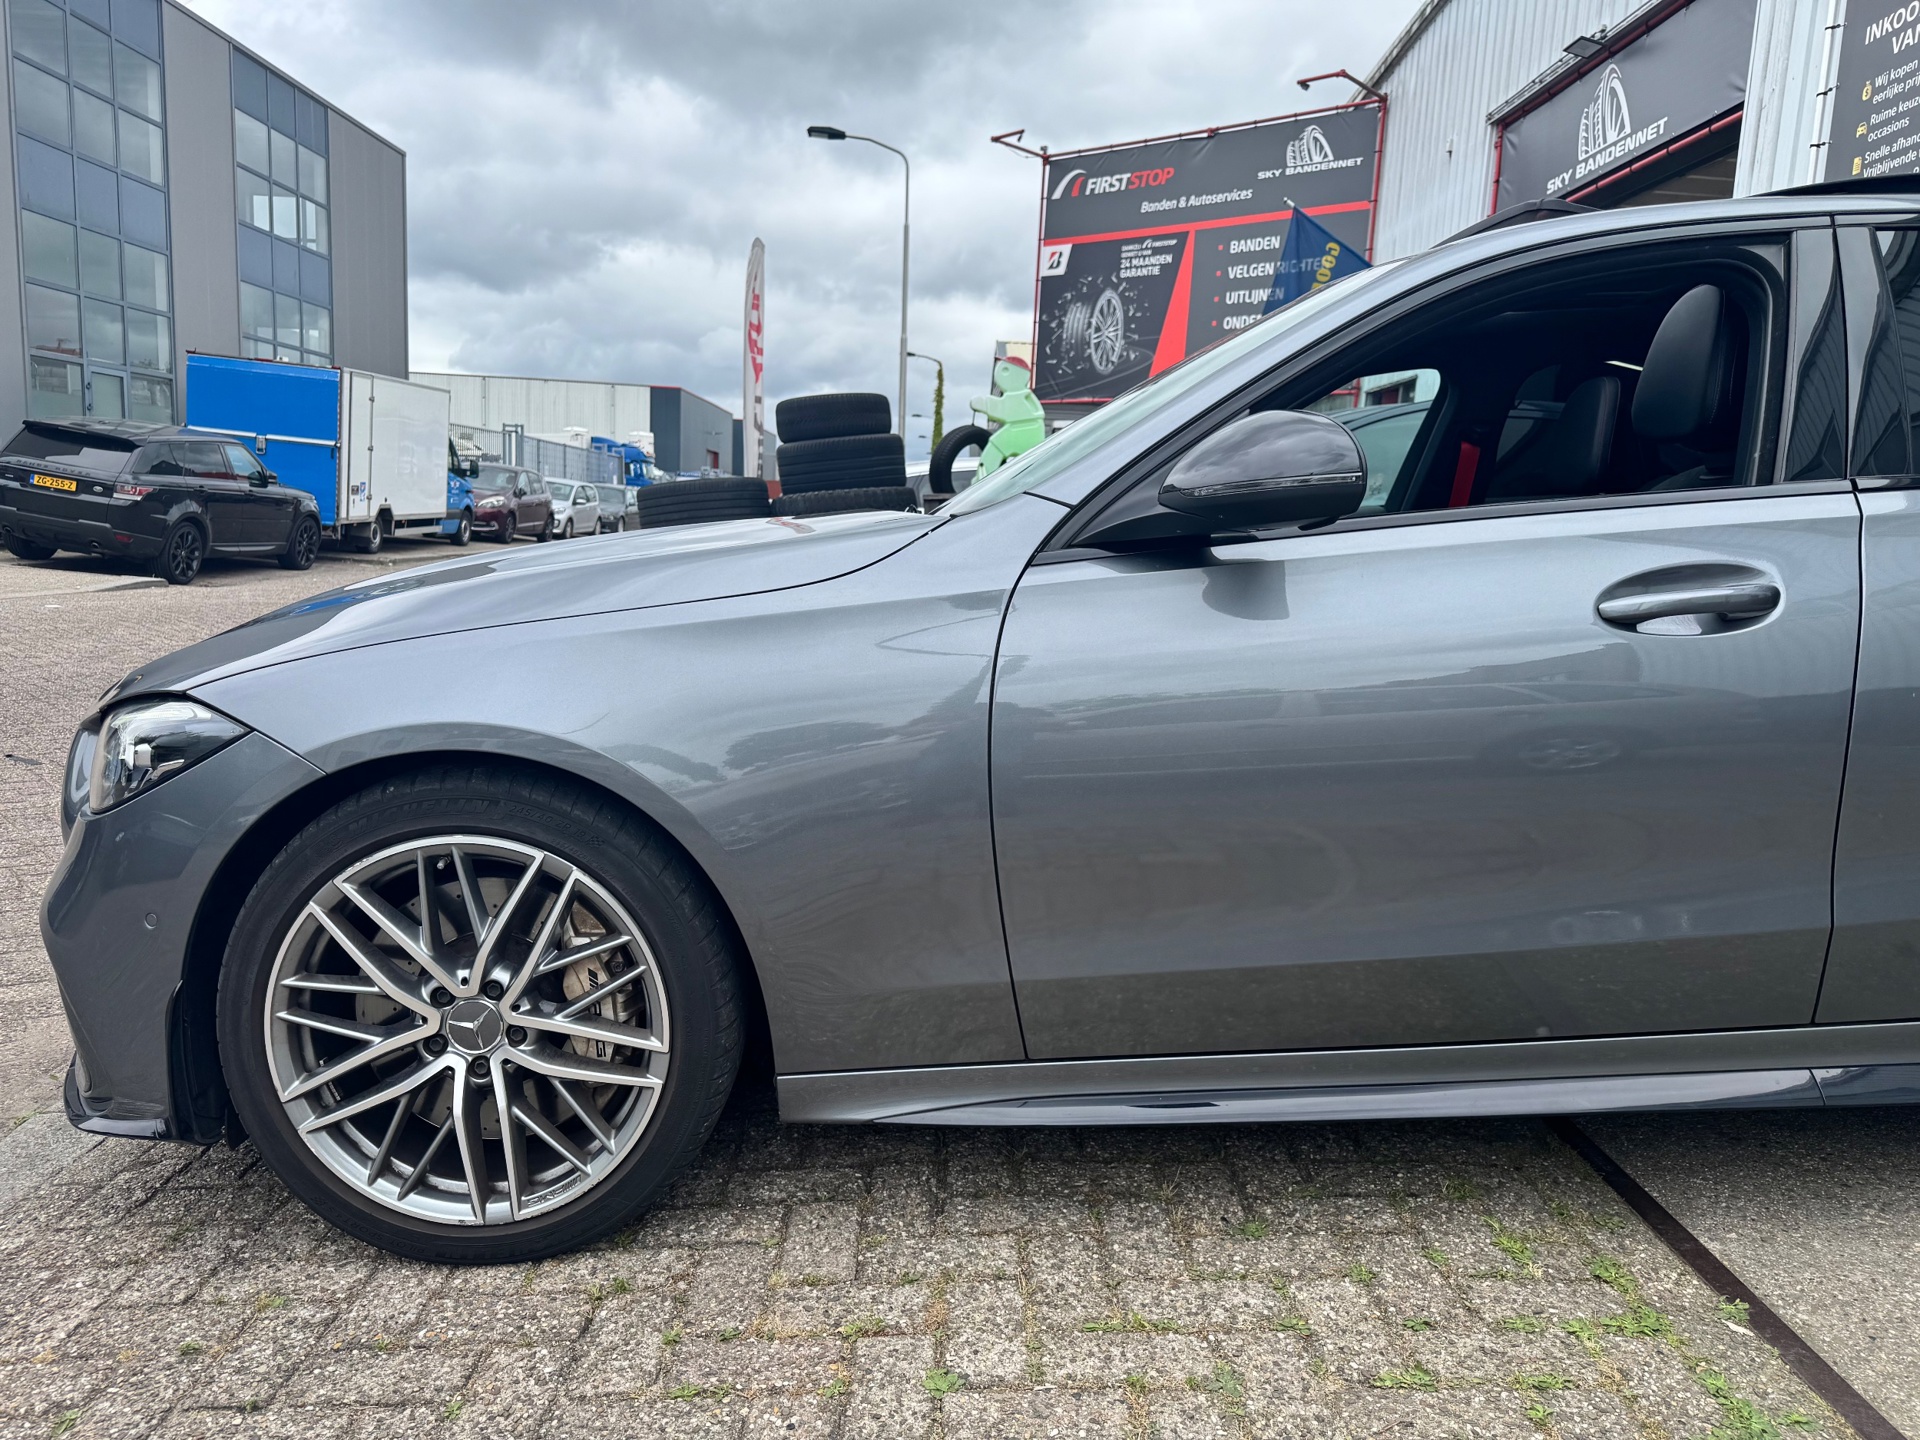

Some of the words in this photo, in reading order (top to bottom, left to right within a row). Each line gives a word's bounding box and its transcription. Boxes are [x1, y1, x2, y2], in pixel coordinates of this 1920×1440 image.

[1865, 0, 1920, 46] INKOO
[1875, 71, 1889, 88] Wij
[1890, 60, 1919, 81] kopen
[1872, 82, 1905, 104] eerlijke
[1870, 106, 1898, 126] Ruime
[1867, 117, 1910, 142] occasions
[1546, 169, 1573, 195] SKY
[1575, 117, 1668, 180] BANDENNET
[1863, 150, 1918, 178] Vrijblijvende
[1864, 145, 1891, 164] Snelle
[1257, 168, 1283, 180] SKY
[1285, 157, 1364, 176] BANDENNET
[1085, 167, 1175, 196] FIRSTSTOP
[1140, 200, 1177, 213] Banden
[1178, 196, 1187, 208] &
[1188, 188, 1253, 208] Autoservices
[1229, 236, 1281, 254] BANDEN
[1119, 265, 1161, 279] GARANTIE
[1120, 258, 1131, 269] 24
[1131, 253, 1173, 268] MAANDEN
[1228, 262, 1275, 280] VELGEN
[1276, 257, 1322, 274] RICHTE
[1225, 287, 1285, 305] UITLIJNEN
[36, 475, 73, 490] ZG-255-Z
[349, 799, 491, 831] MICHELIN
[508, 804, 554, 823] 245/40
